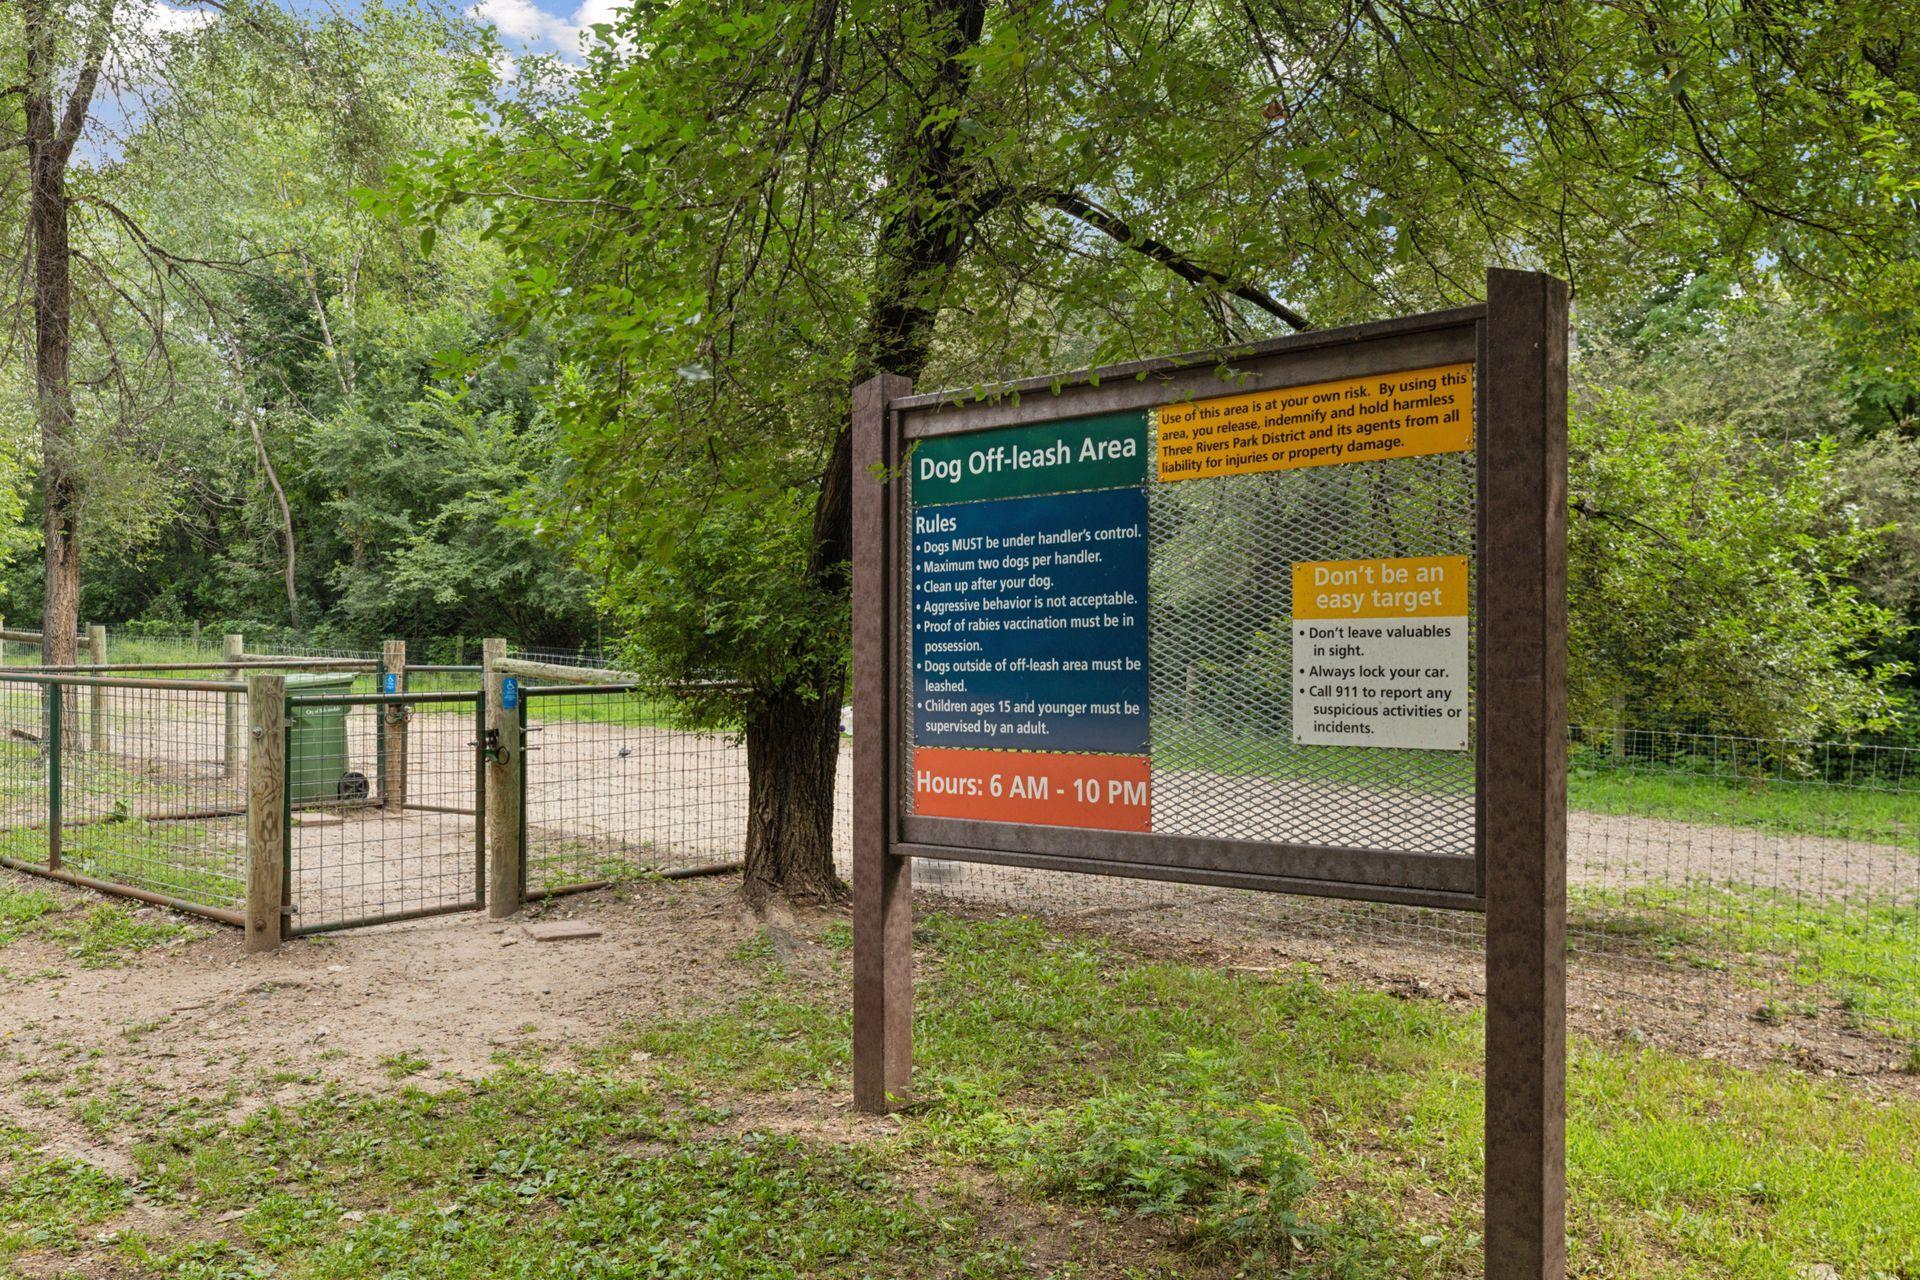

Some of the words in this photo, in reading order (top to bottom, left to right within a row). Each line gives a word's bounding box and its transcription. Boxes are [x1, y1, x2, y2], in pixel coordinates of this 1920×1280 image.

[1162, 413, 1182, 425] Use
[1184, 409, 1197, 422] of
[1200, 406, 1220, 419] this
[1223, 404, 1249, 416] area
[1252, 400, 1262, 412] is
[1265, 399, 1277, 410] at
[1281, 395, 1309, 411] your
[1312, 392, 1341, 404] own
[1344, 385, 1371, 400] risk.
[1379, 383, 1396, 397] By
[1399, 378, 1437, 392] using
[1441, 372, 1467, 387] this
[1162, 430, 1189, 441] area,
[1192, 425, 1213, 440] you
[1216, 421, 1261, 433] release,
[1264, 409, 1327, 428] indemnify
[1331, 405, 1355, 419] and
[1359, 400, 1389, 415] hold
[1393, 394, 1455, 411] harmless
[1162, 444, 1193, 457] Three
[1196, 440, 1230, 453] Rivers
[1233, 435, 1259, 449] Park
[1262, 429, 1306, 445] District
[1309, 425, 1333, 439] and
[1337, 423, 1353, 436] its
[1356, 418, 1401, 435] agents
[1405, 414, 1439, 427] from
[1443, 409, 1460, 423] all
[920, 457, 962, 484] Dog
[968, 439, 1071, 475] Off-leash
[1078, 437, 1137, 463] Area
[1162, 459, 1203, 473] liability
[1206, 456, 1223, 468] for
[1226, 451, 1268, 468] injuries
[1271, 450, 1285, 461] or
[1288, 444, 1343, 462] property
[1347, 437, 1405, 453] damage.
[915, 513, 957, 534] Rules
[923, 541, 949, 556] Dogs
[952, 536, 983, 552] MUST
[986, 535, 1000, 549] be
[1002, 533, 1036, 548] under
[1038, 528, 1091, 545] handler's
[1094, 523, 1142, 541] control.
[923, 559, 975, 574] Maximum
[978, 557, 1000, 570] two
[1001, 553, 1030, 570] dogs
[1032, 554, 1052, 569] per
[1054, 549, 1102, 565] handler.
[923, 579, 952, 594] Clean
[954, 581, 968, 595] up
[970, 576, 997, 591] after
[999, 576, 1026, 592] your
[1028, 574, 1054, 590] dog.
[1314, 565, 1375, 587] Don't
[1381, 563, 1408, 584] be
[1416, 565, 1444, 583] an
[923, 598, 980, 616] Aggressive
[982, 594, 1031, 611] behavior
[1034, 596, 1044, 608] is
[1046, 594, 1067, 608] not
[1069, 590, 1138, 608] acceptable.
[1316, 592, 1365, 613] easy
[1371, 586, 1443, 612] target
[923, 618, 952, 633] Proof
[954, 618, 966, 632] of
[968, 617, 1001, 631] rabies
[1003, 615, 1067, 630] vaccination
[1070, 615, 1101, 629] must
[1103, 613, 1119, 628] be
[1122, 613, 1135, 627] in
[1309, 626, 1344, 639] Don't
[1348, 626, 1383, 638] leave
[1386, 624, 1451, 638] valuables
[924, 639, 983, 655] possession.
[1313, 644, 1325, 657] in
[1328, 644, 1365, 659] sight.
[924, 660, 950, 675] Dogs
[952, 658, 992, 672] outside
[994, 658, 1007, 672] of
[1009, 658, 1060, 672] off-leash
[1062, 660, 1088, 672] area
[1091, 658, 1123, 671] must
[1125, 656, 1142, 672] be
[1309, 665, 1356, 680] Always
[1359, 665, 1385, 678] lock
[1389, 667, 1421, 680] your
[1424, 668, 1449, 678] car.
[925, 679, 968, 692] leashed.
[1309, 685, 1332, 698] Call
[1336, 686, 1358, 698] 911
[1362, 687, 1376, 698] to
[1380, 688, 1423, 701] report
[1426, 688, 1452, 702] any
[924, 699, 968, 713] Children
[970, 702, 995, 715] ages
[998, 700, 1011, 713] 15
[1013, 700, 1035, 714] and
[1038, 704, 1087, 717] younger
[1090, 703, 1121, 715] must
[1124, 701, 1140, 715] be
[1313, 703, 1379, 718] suspicious
[1382, 704, 1443, 718] activities
[1447, 706, 1462, 719] or
[925, 719, 981, 735] supervised
[983, 719, 997, 737] by
[999, 722, 1014, 734] an
[1016, 721, 1050, 735] adult.
[1313, 721, 1375, 734] incidents.
[916, 770, 983, 797] Hours:
[989, 773, 1002, 798] 6
[1009, 775, 1049, 801] AM
[1073, 777, 1100, 804] 10
[1108, 780, 1148, 806] PM
